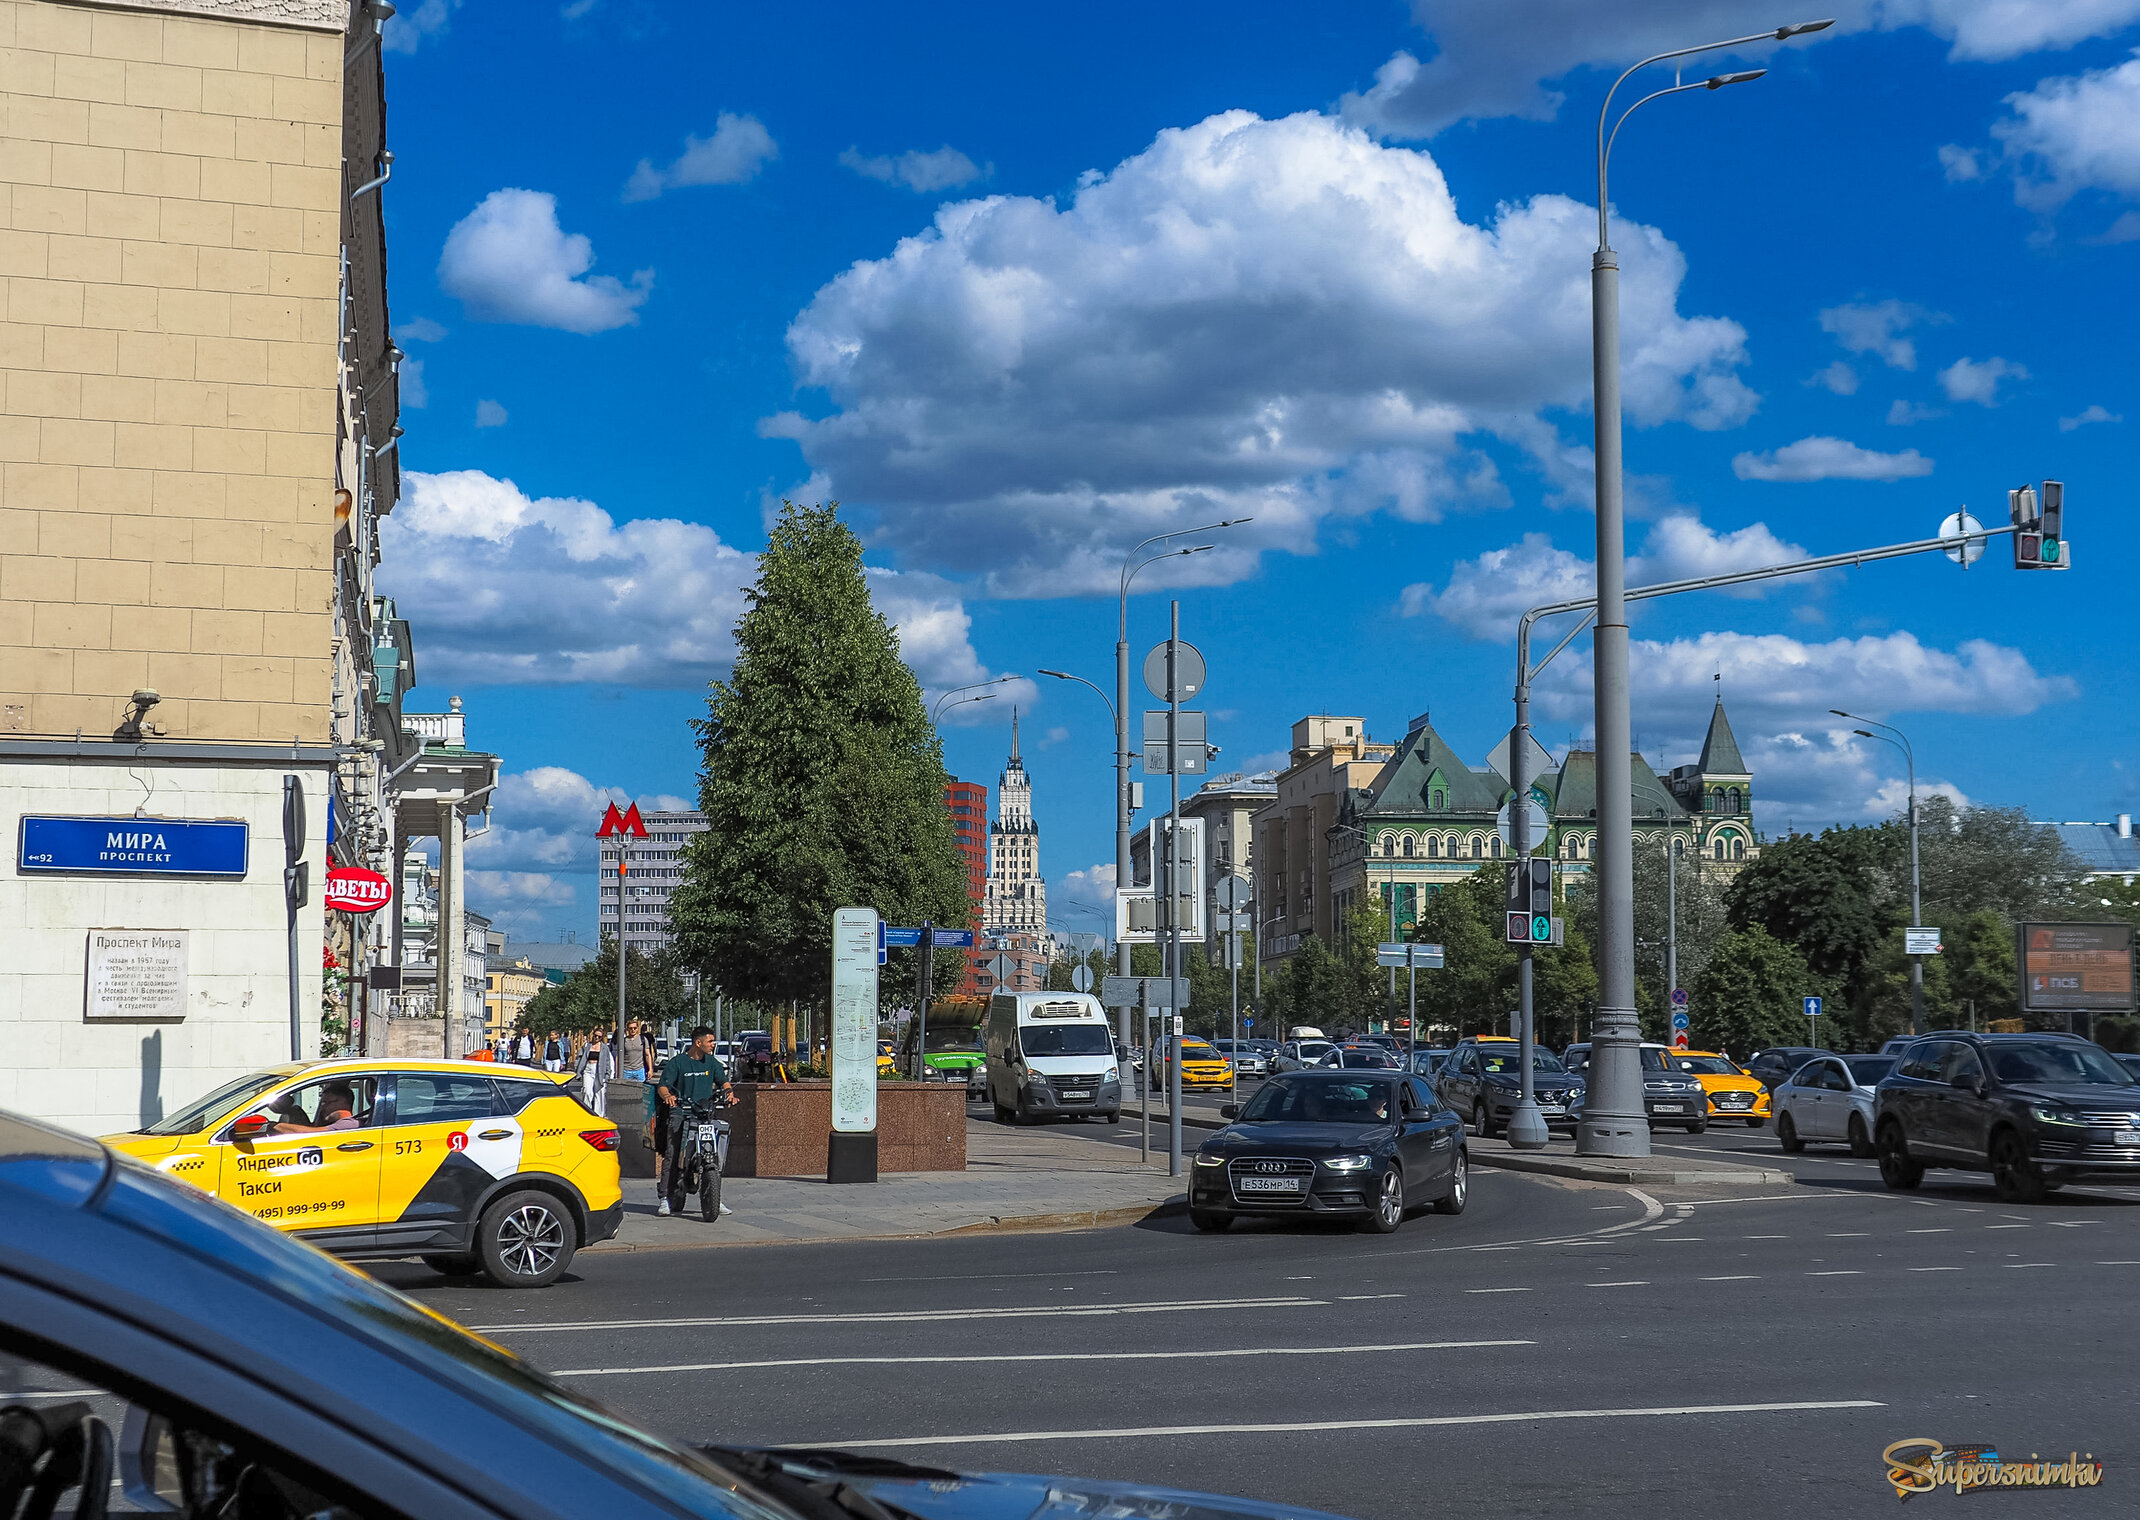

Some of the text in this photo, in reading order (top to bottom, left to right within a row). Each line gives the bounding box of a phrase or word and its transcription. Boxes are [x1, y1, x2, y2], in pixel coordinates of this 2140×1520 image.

[595, 800, 650, 838] М
[106, 832, 167, 850] МИРА
[39, 854, 53, 862] 92
[99, 851, 172, 863] ПРОСПЕКТ
[325, 878, 388, 899] ЦВЕТЫ
[96, 936, 181, 949] Проспект Мира
[395, 1139, 422, 1155] 573
[450, 1135, 463, 1151] Я
[237, 1151, 321, 1171] Яндекс Go
[237, 1181, 282, 1197] Такси
[253, 1200, 346, 1219] (495) 999-99-99
